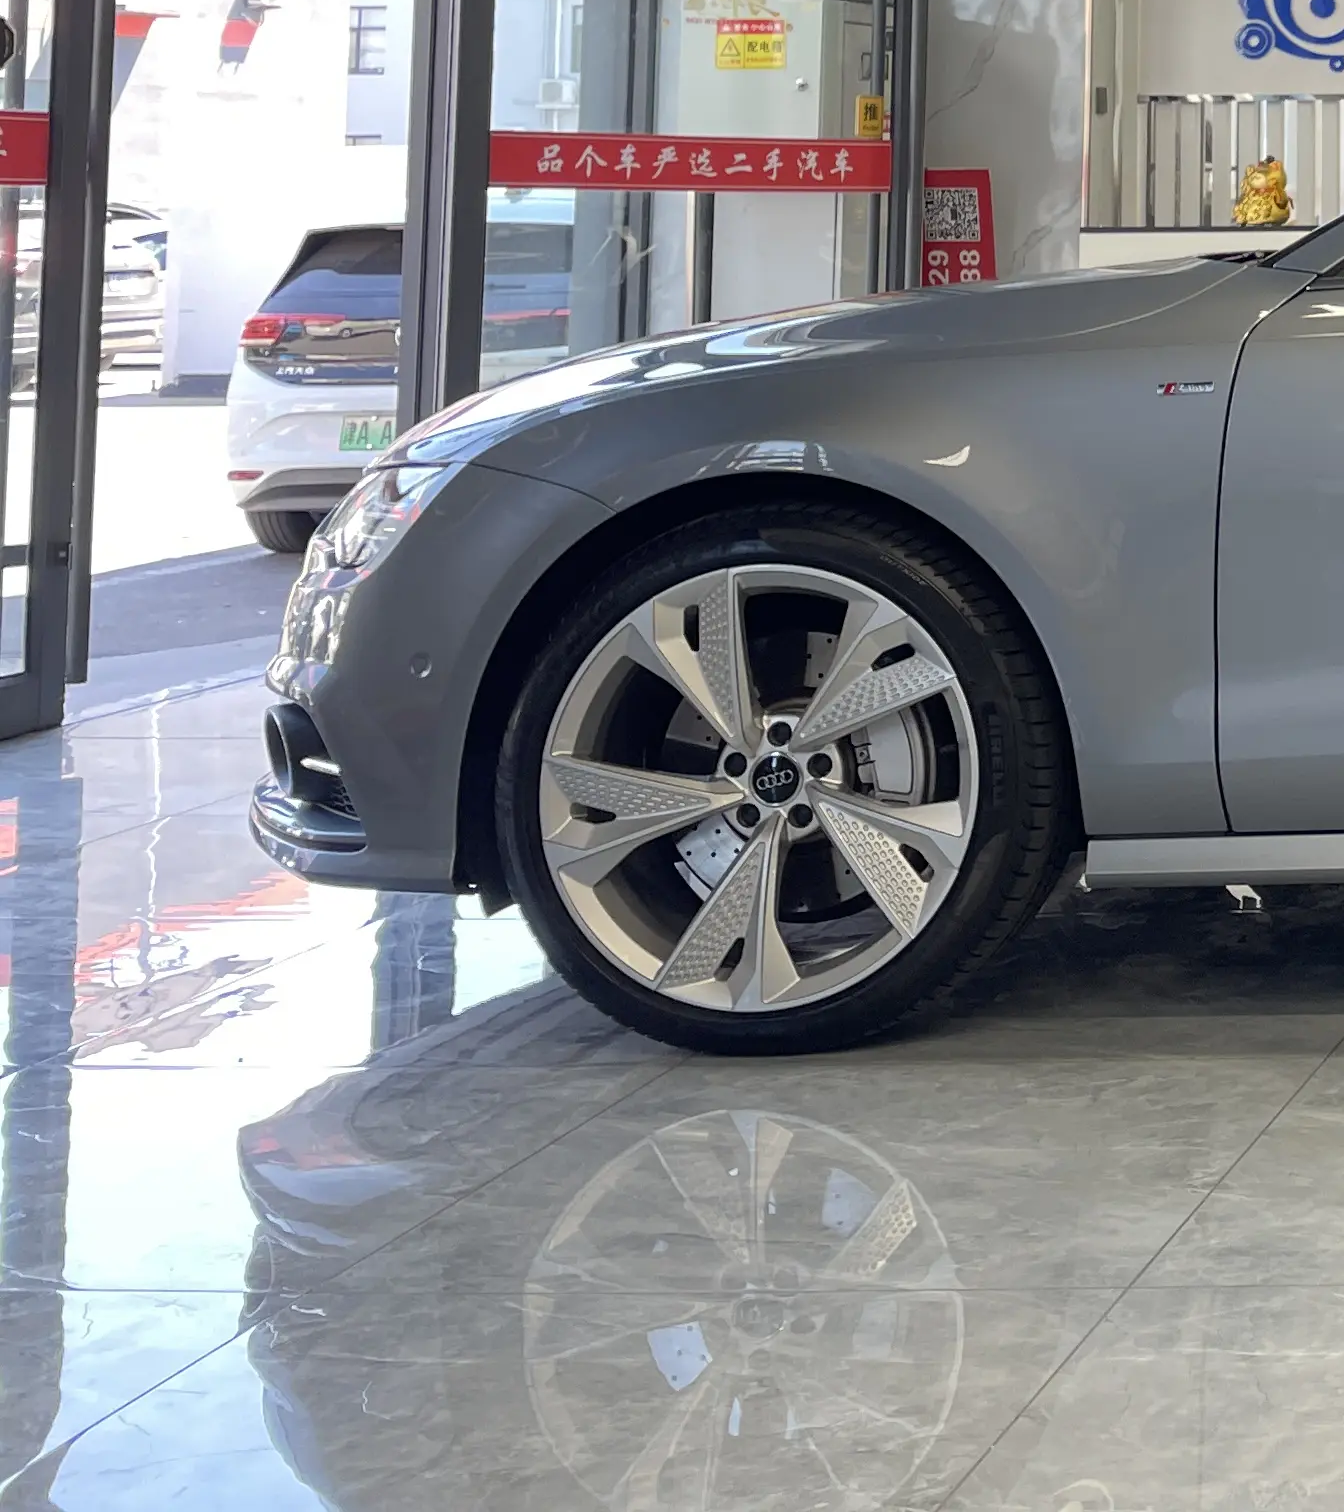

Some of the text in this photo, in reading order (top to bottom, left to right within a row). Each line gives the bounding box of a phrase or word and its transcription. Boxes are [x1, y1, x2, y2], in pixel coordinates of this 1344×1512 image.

[863, 102, 879, 122] 推
[536, 143, 855, 182] 品个车严选二手汽车
